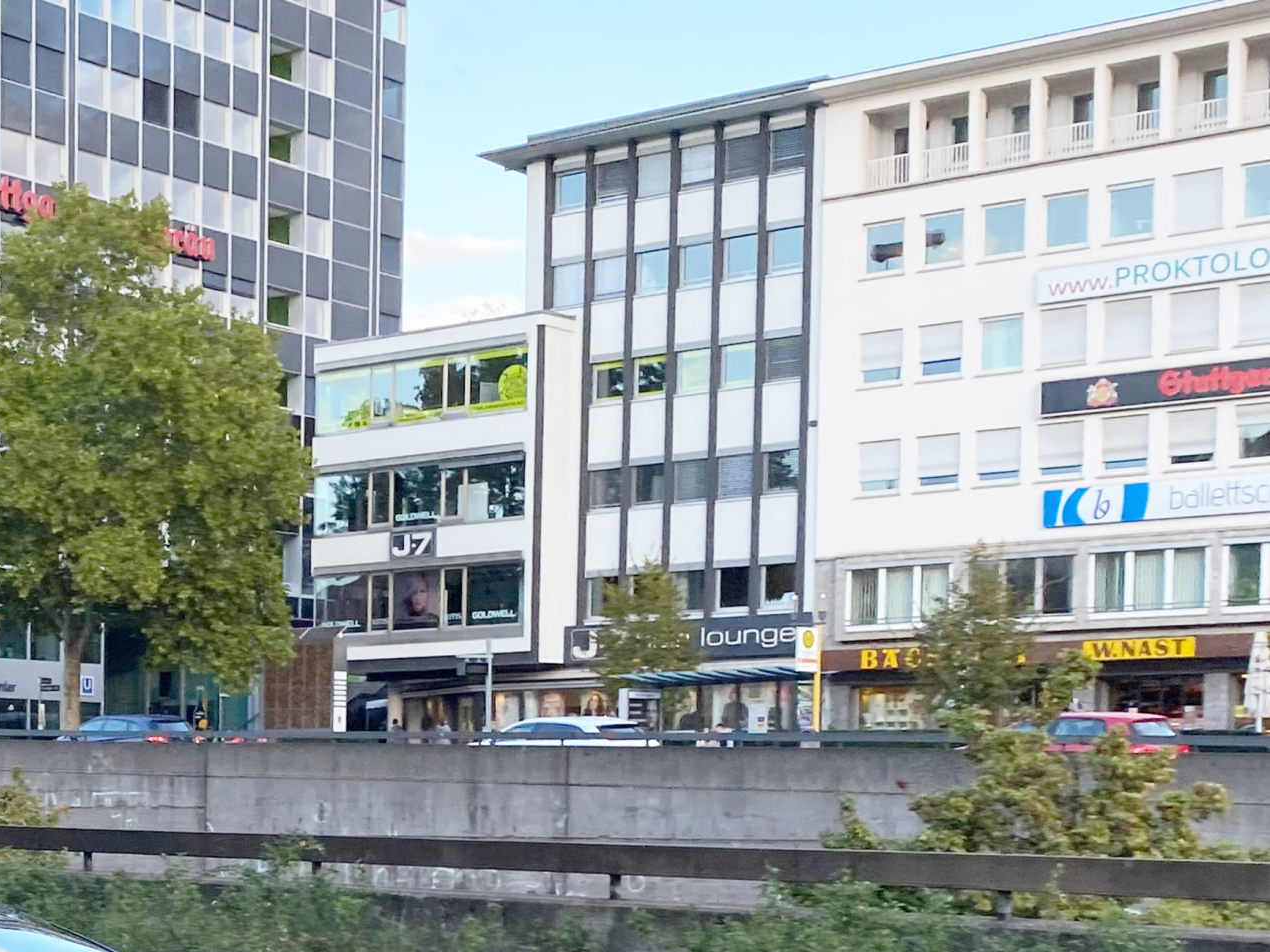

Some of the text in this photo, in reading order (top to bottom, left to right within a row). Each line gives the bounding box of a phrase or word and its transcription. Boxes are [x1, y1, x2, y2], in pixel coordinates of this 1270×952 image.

[1049, 247, 1270, 297] www.PROKTOLO
[471, 609, 515, 620] GOLDWELL
[700, 626, 796, 648] lounge
